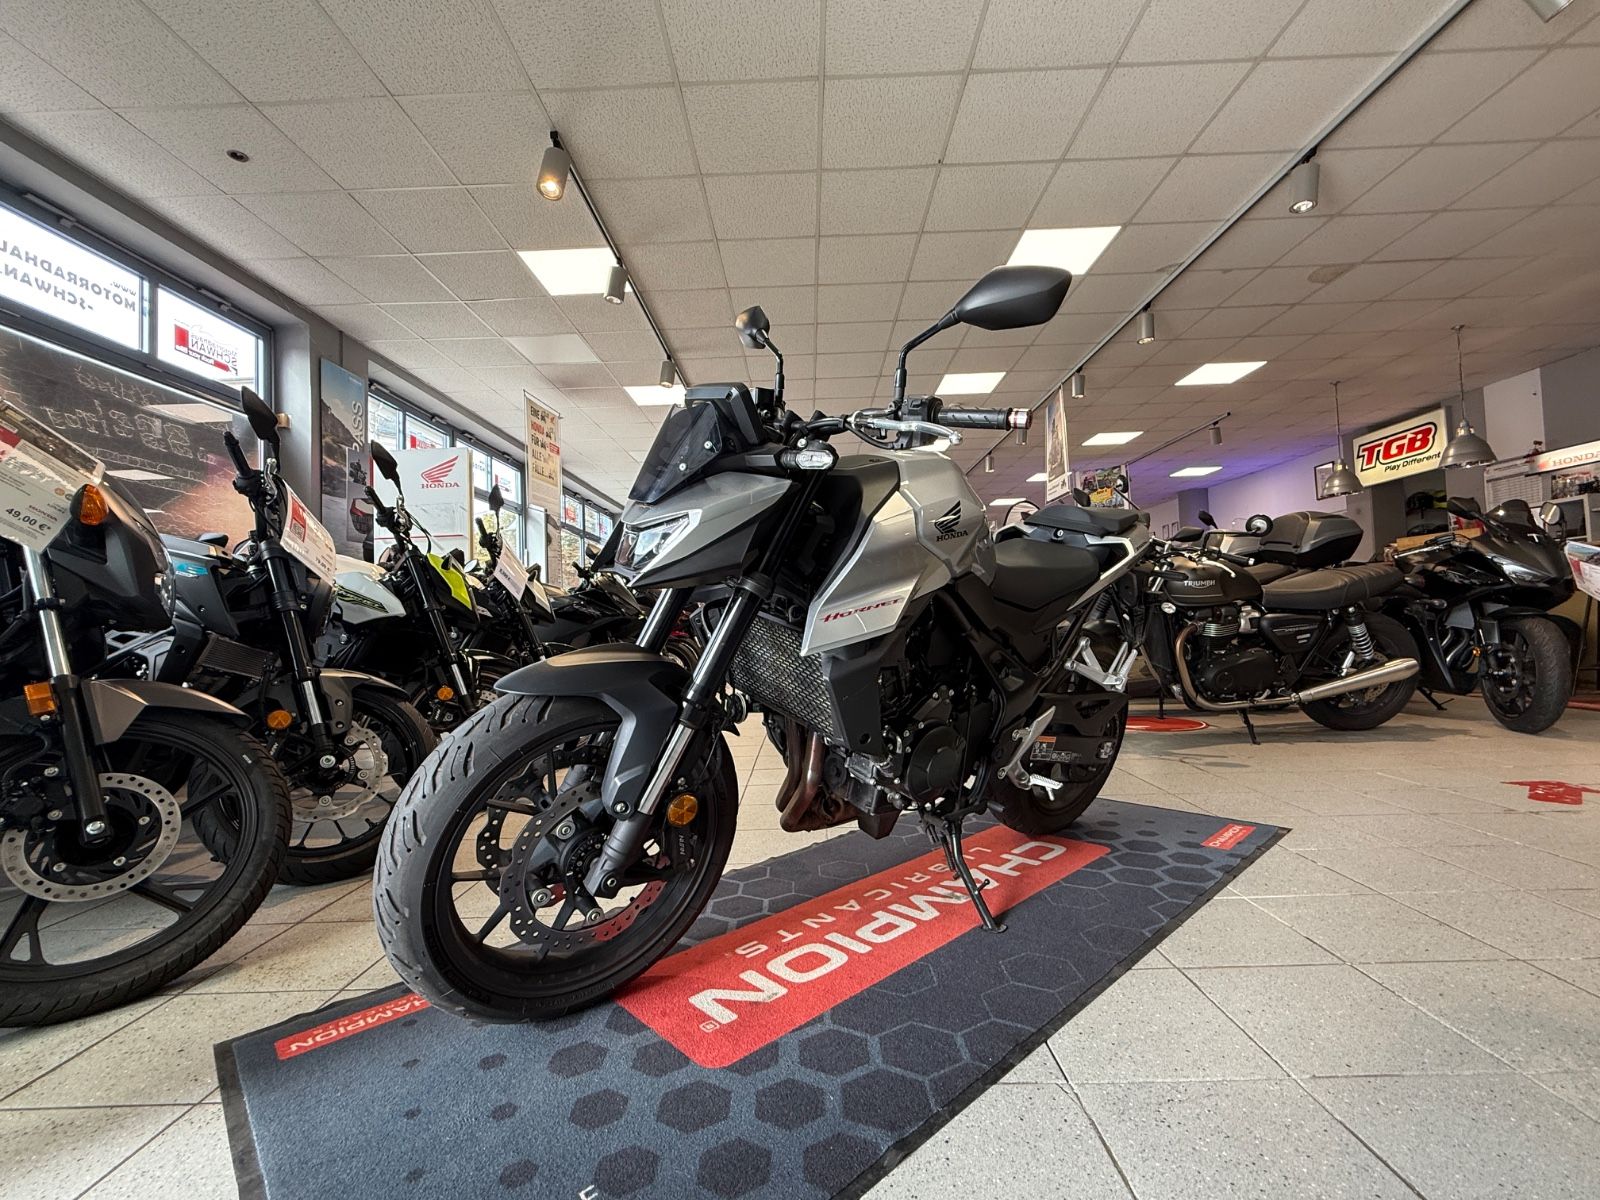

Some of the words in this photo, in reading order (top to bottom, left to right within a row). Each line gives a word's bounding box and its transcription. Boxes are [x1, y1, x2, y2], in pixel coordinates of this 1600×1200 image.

[1358, 423, 1436, 470] TGB
[1384, 462, 1401, 473] Play
[1402, 450, 1442, 467] Different
[5, 507, 37, 526] 49,00
[936, 529, 969, 542] HONDA
[1183, 579, 1216, 588] TRIUMPH
[688, 840, 1067, 1025] CHAMPION
[289, 999, 427, 1052] HAMPION
